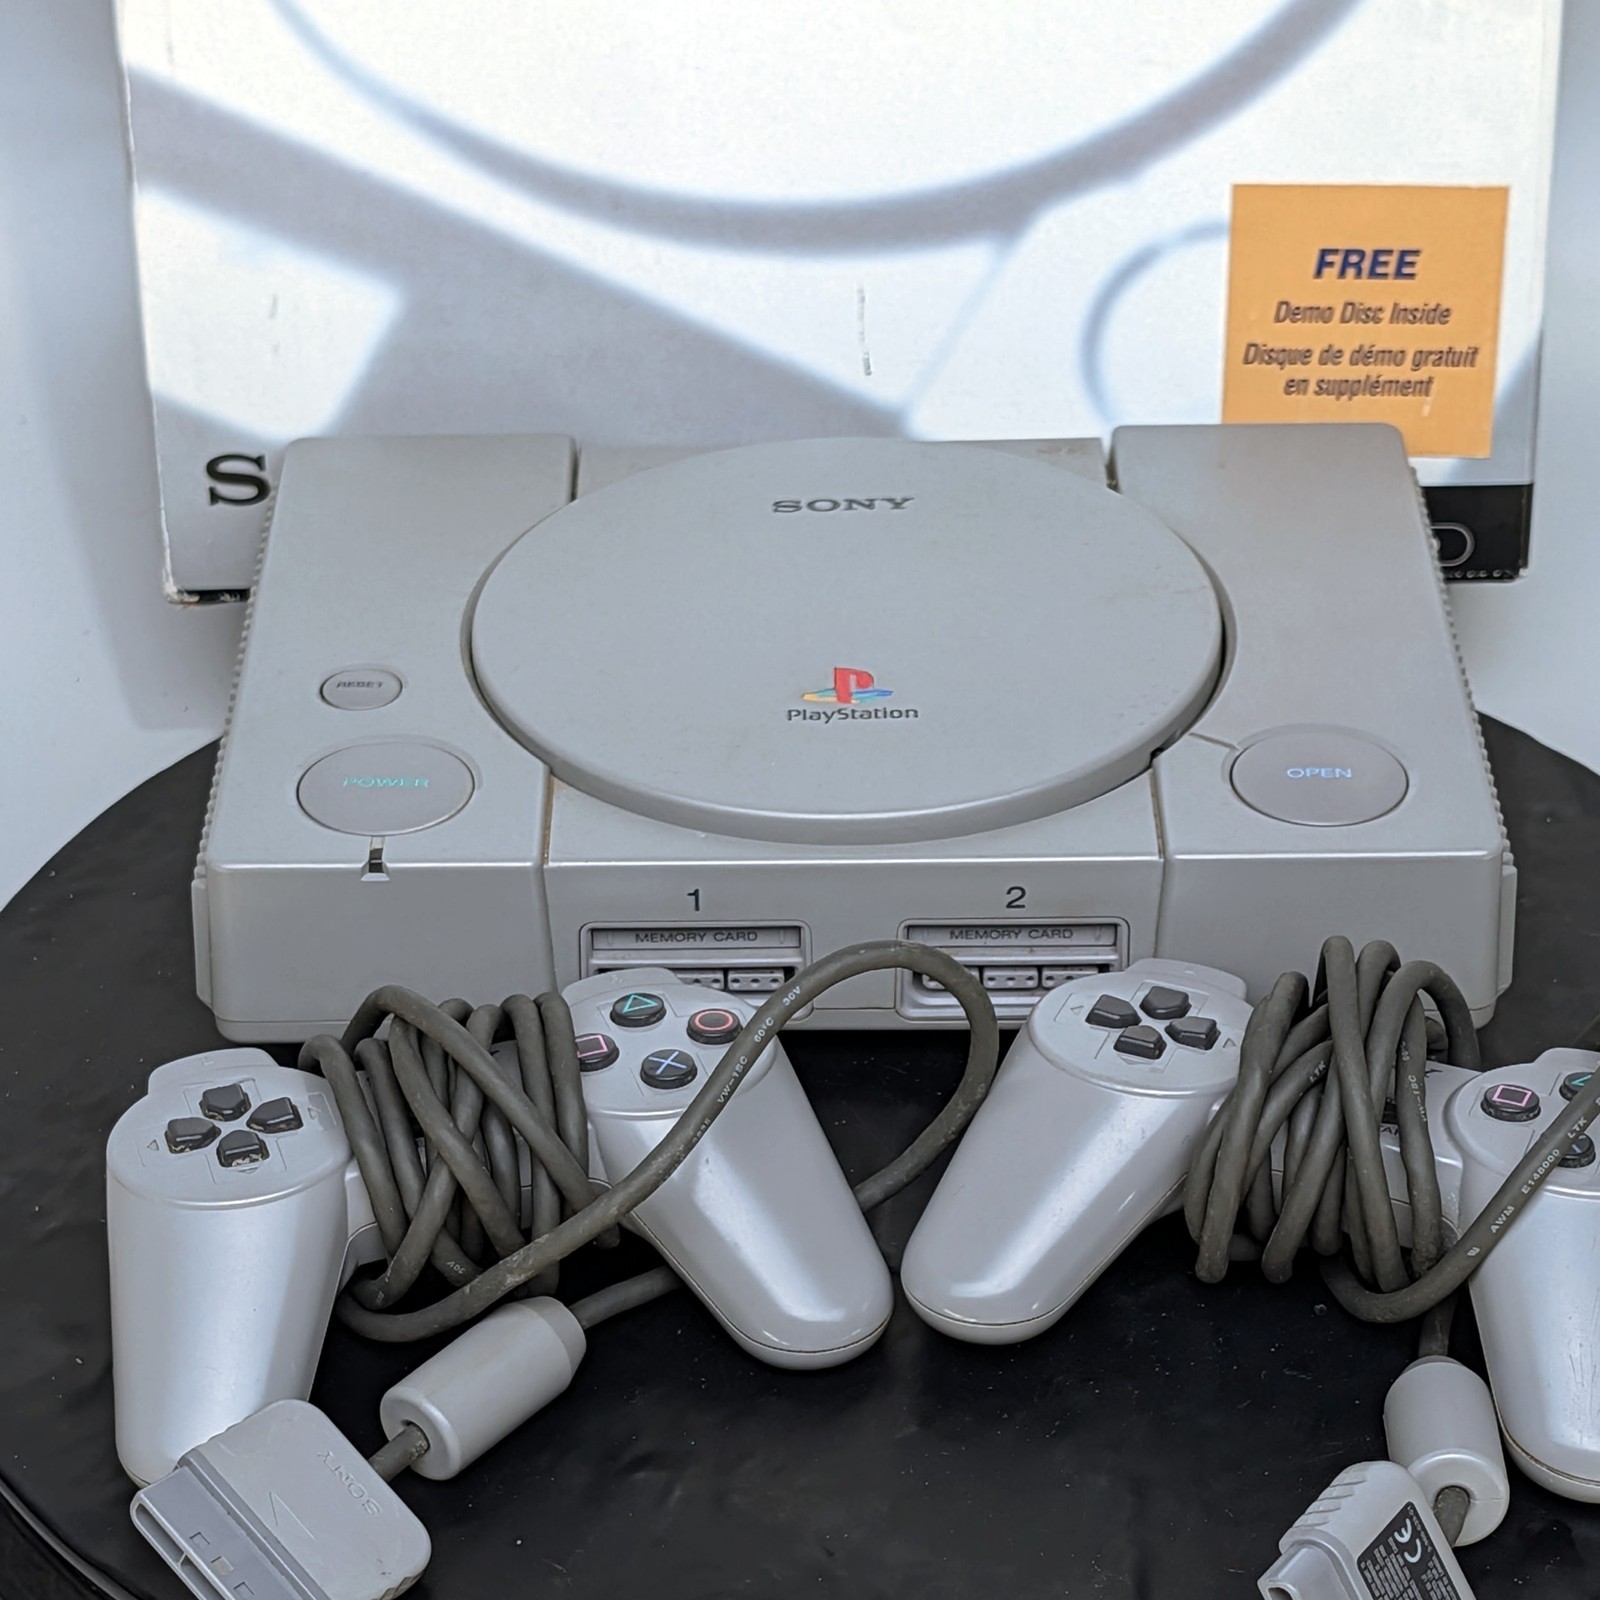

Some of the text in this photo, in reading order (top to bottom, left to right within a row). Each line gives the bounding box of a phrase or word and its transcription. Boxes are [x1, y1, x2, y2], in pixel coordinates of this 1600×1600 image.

[1313, 248, 1422, 281] FREE
[1274, 300, 1453, 325] Demo Disc Inside
[1242, 342, 1480, 371] Disque de démo gratuit
[1283, 375, 1434, 401] en supplément
[206, 454, 271, 506] S
[771, 497, 915, 513] SONY
[336, 680, 384, 689] RESET
[786, 707, 919, 724] PlayStation
[342, 776, 430, 789] POWER
[1286, 767, 1353, 778] OPEN
[686, 888, 700, 912] 1
[1005, 886, 1027, 909] 2
[635, 930, 759, 943] MEMORY CARD
[949, 928, 1074, 940] MEMORY CARD
[1490, 1205, 1515, 1234] AWM
[316, 1450, 383, 1516] SONY
